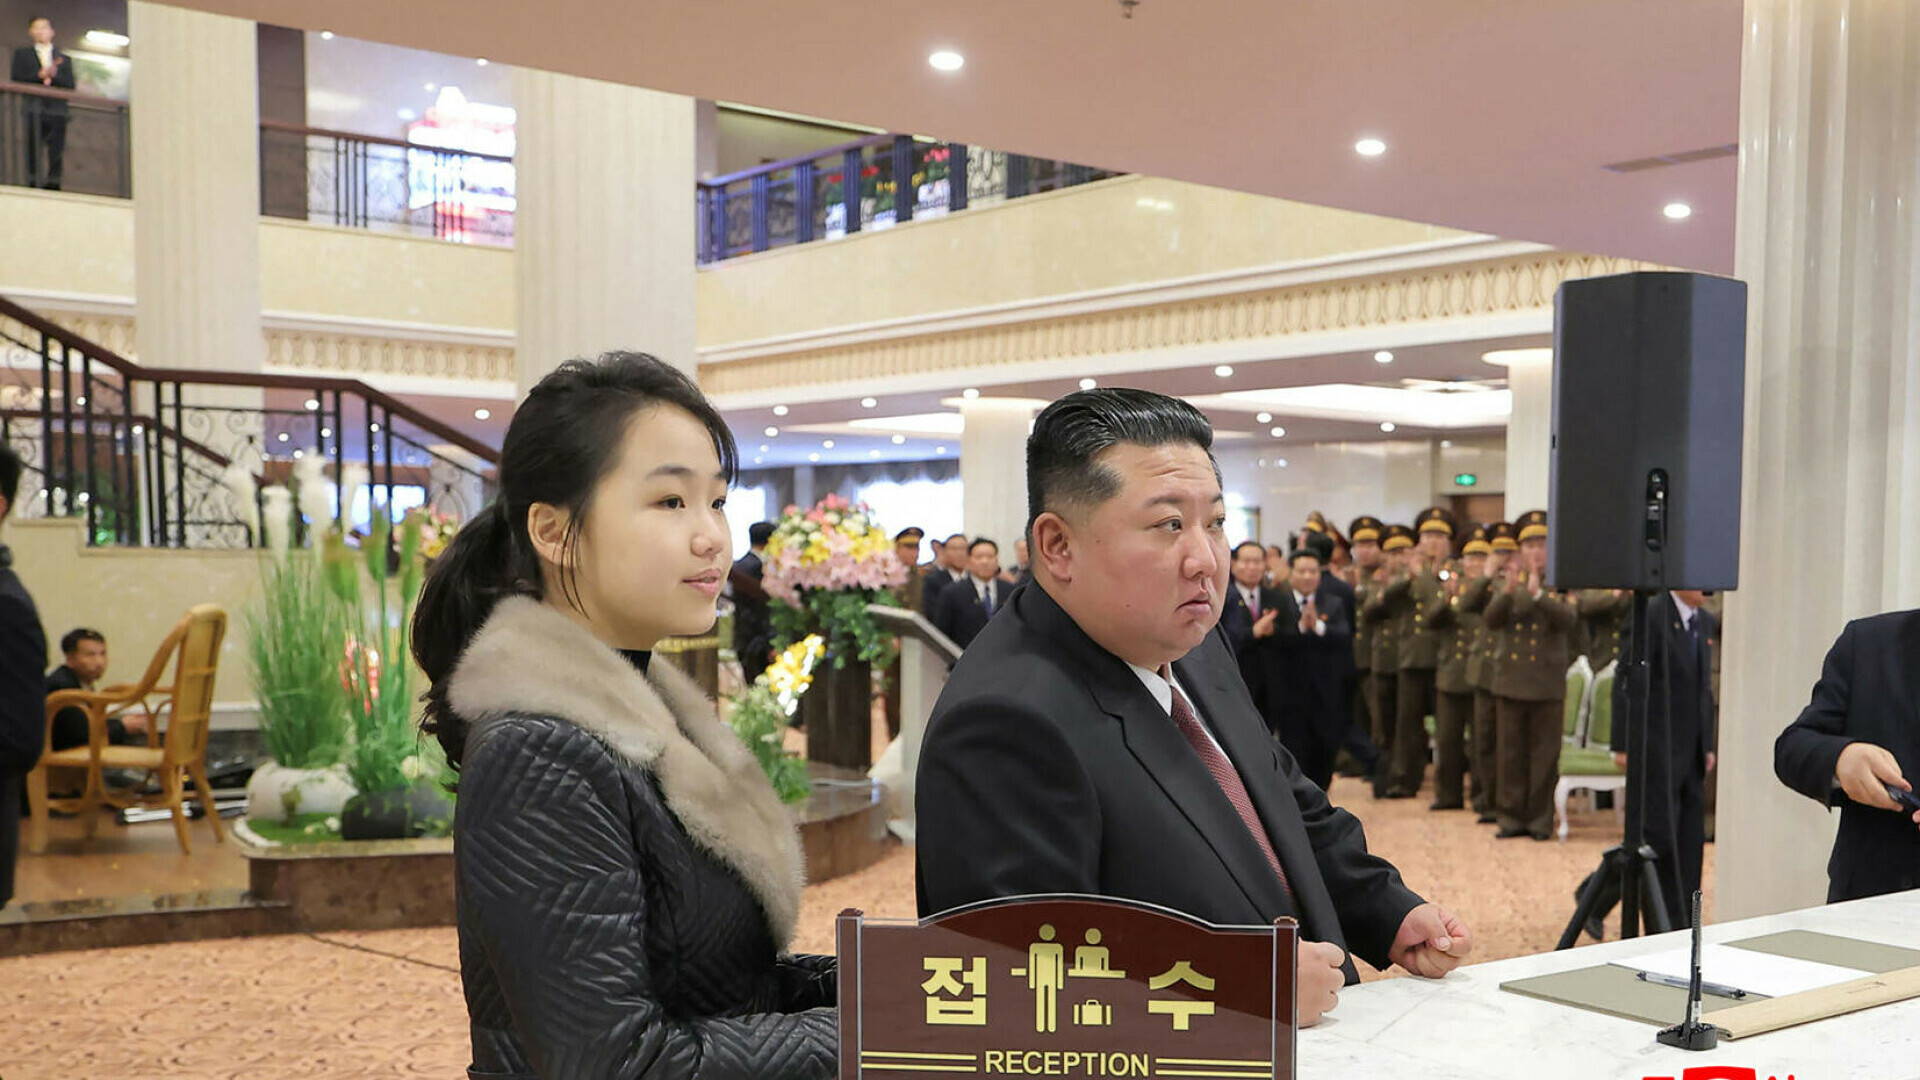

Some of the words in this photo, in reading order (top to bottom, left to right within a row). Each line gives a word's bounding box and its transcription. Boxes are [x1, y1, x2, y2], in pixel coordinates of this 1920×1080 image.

[920, 956, 987, 1026] 접
[1147, 960, 1216, 1031] 수
[984, 1050, 1150, 1077] RECEPTION
